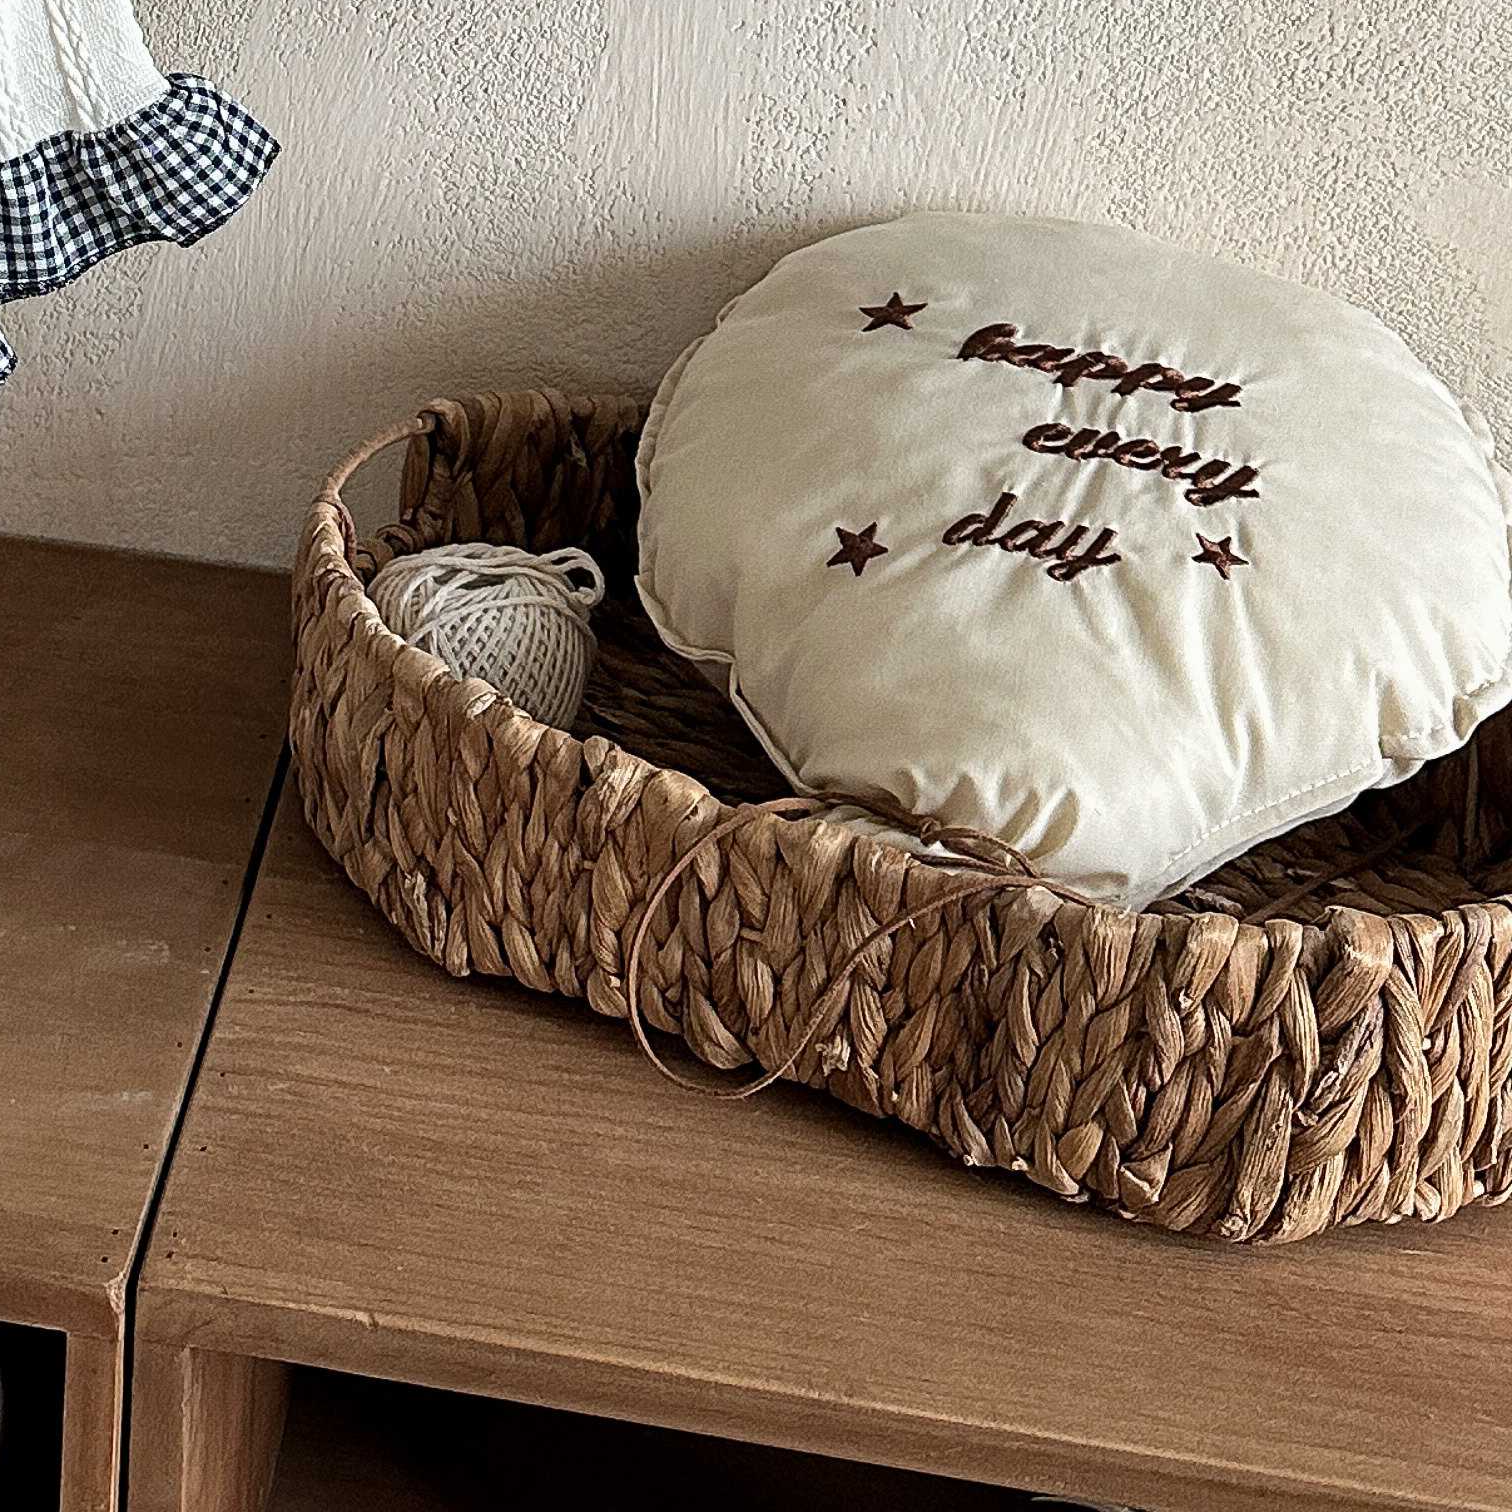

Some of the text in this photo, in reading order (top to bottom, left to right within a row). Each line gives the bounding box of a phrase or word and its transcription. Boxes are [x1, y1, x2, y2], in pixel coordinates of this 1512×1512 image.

[955, 322, 1242, 414] happy
[1021, 422, 1260, 508] every
[941, 491, 1122, 582] day
